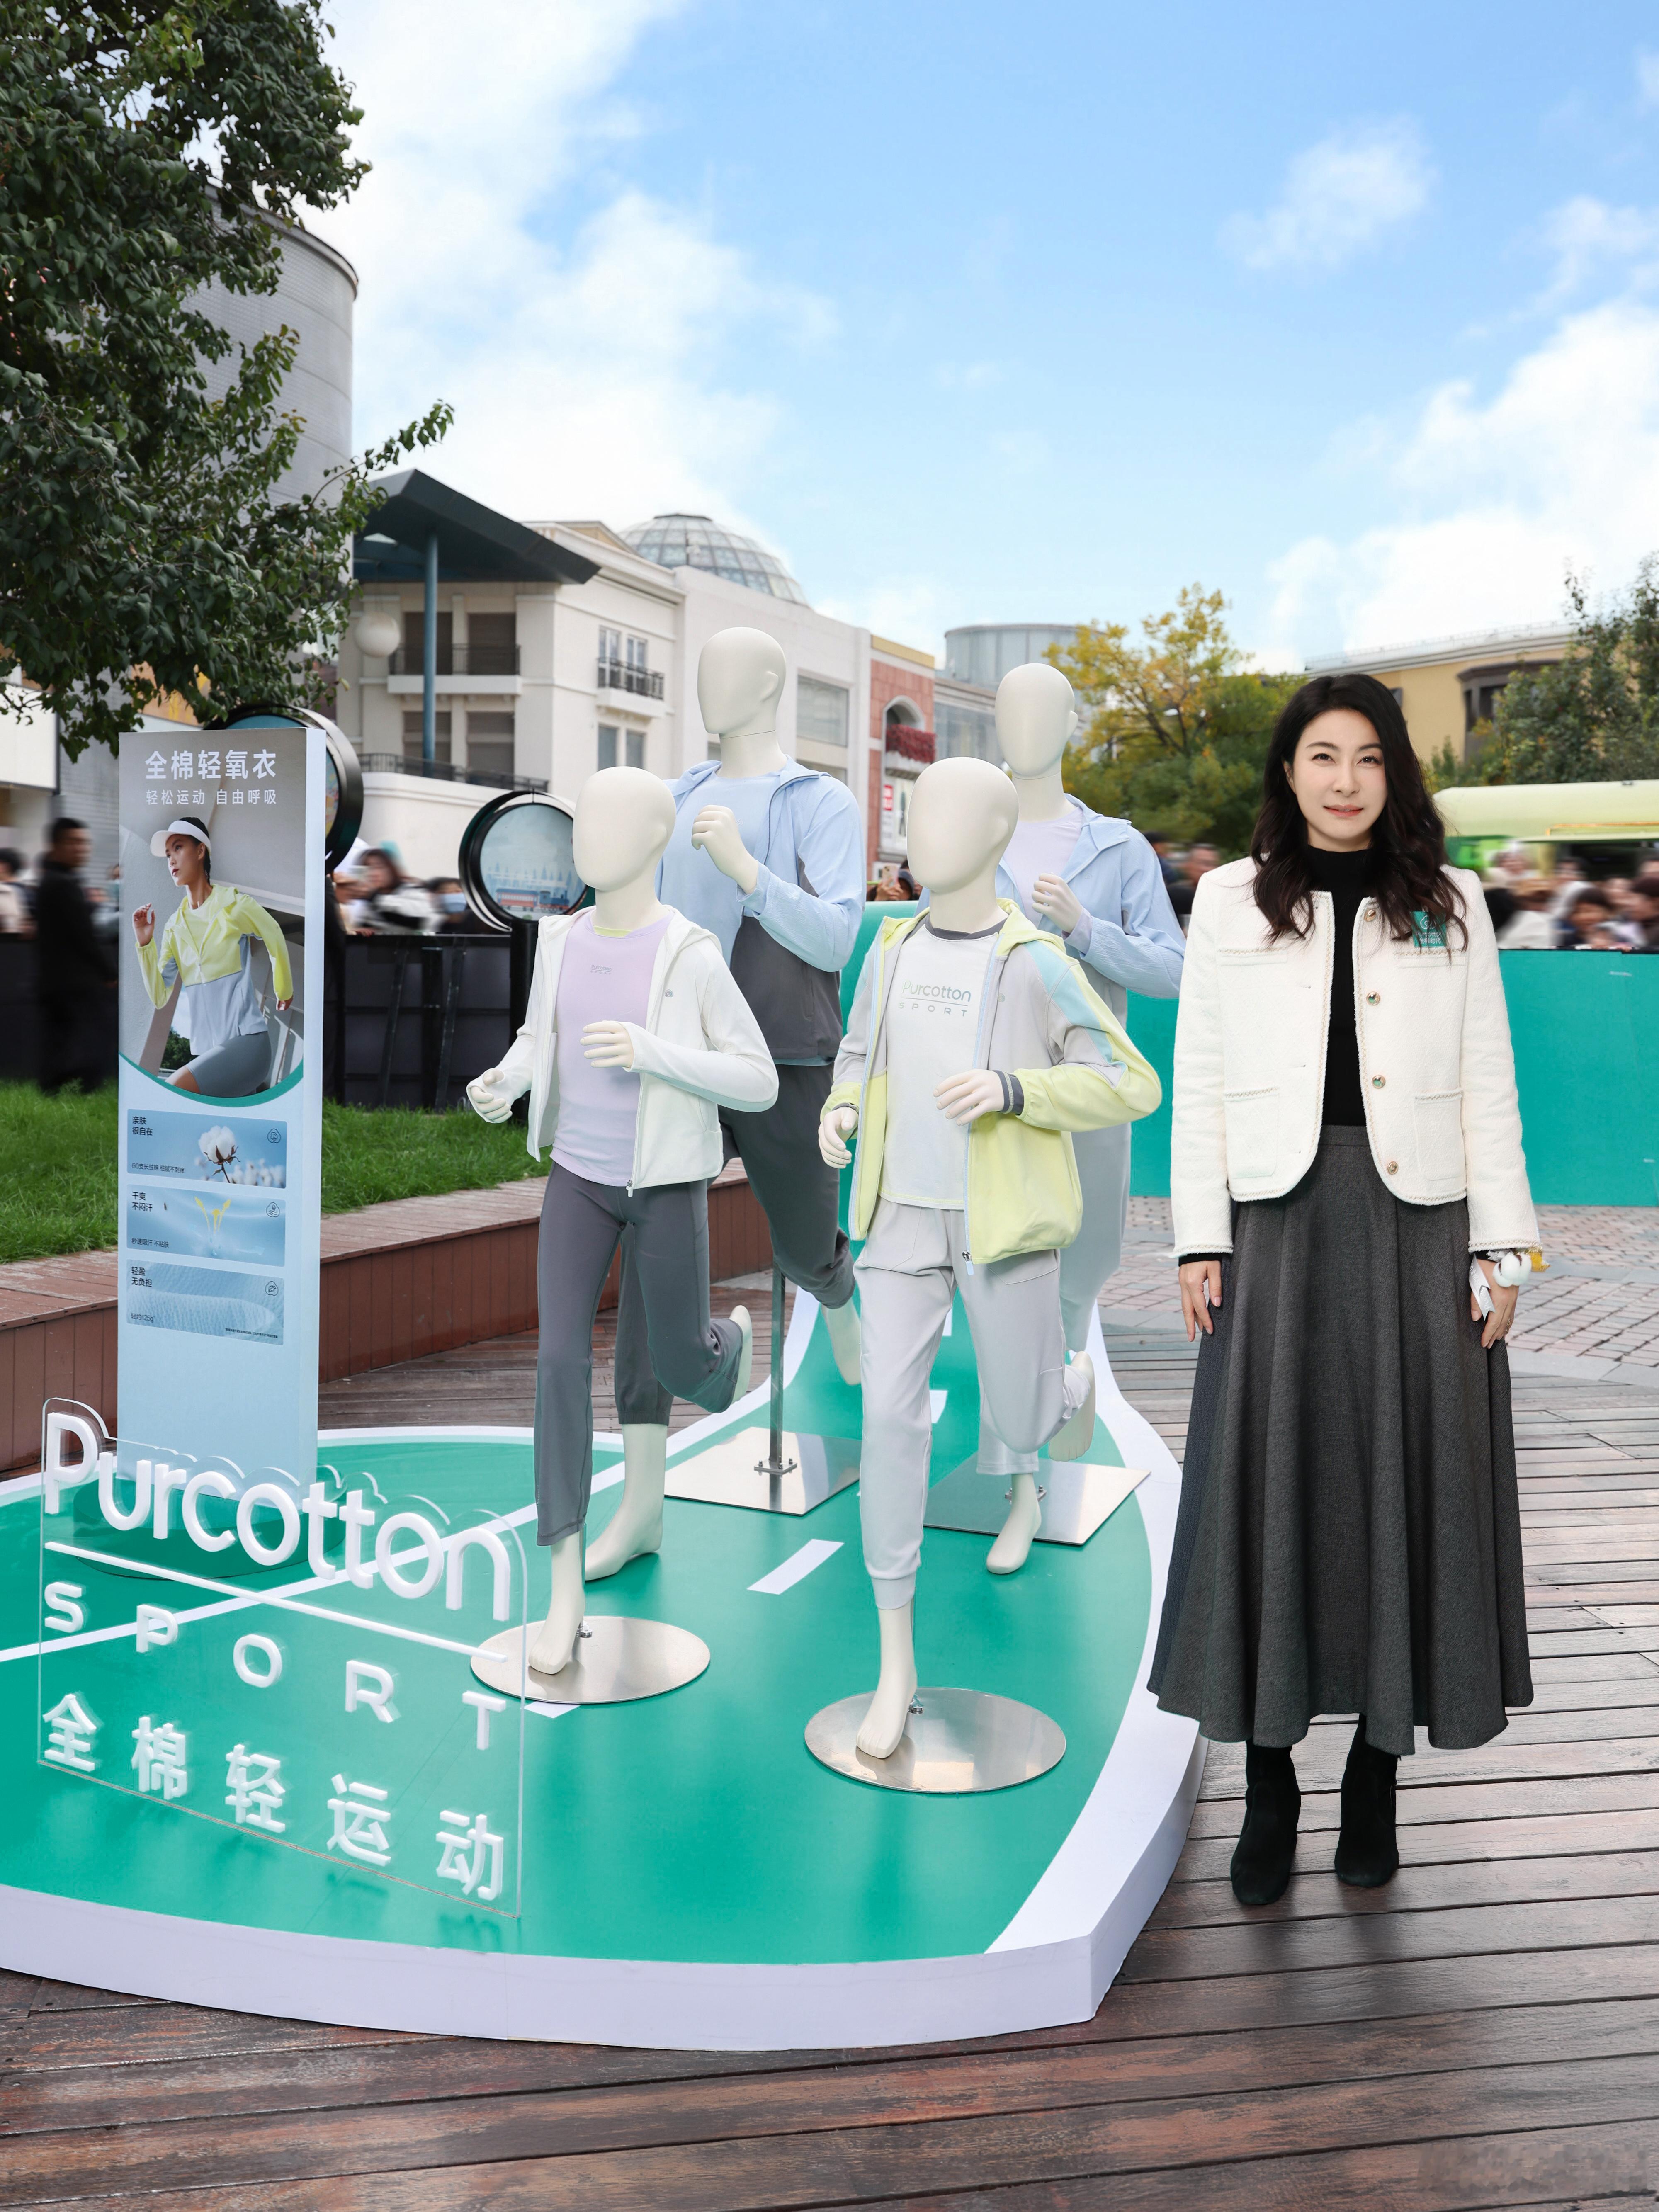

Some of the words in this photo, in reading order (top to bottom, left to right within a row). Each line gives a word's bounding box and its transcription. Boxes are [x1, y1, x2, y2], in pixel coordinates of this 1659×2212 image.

[145, 749, 277, 779] 全棉轻氧衣
[146, 789, 205, 804] 轻松运动
[216, 789, 277, 804] 自由呼吸
[902, 979, 971, 1002] Purcotton
[899, 1002, 967, 1017] SPORT
[132, 1116, 146, 1125] 亲肤
[132, 1127, 153, 1136] 很自在
[132, 1191, 146, 1201] 干爽
[132, 1202, 153, 1212] 不闷汗
[131, 1266, 146, 1276] 轻盈
[131, 1277, 152, 1287] 无负担
[45, 1412, 510, 1621] Purcotton
[44, 1581, 506, 1750] SPORT
[43, 1694, 505, 1900] 全棉轻运动
